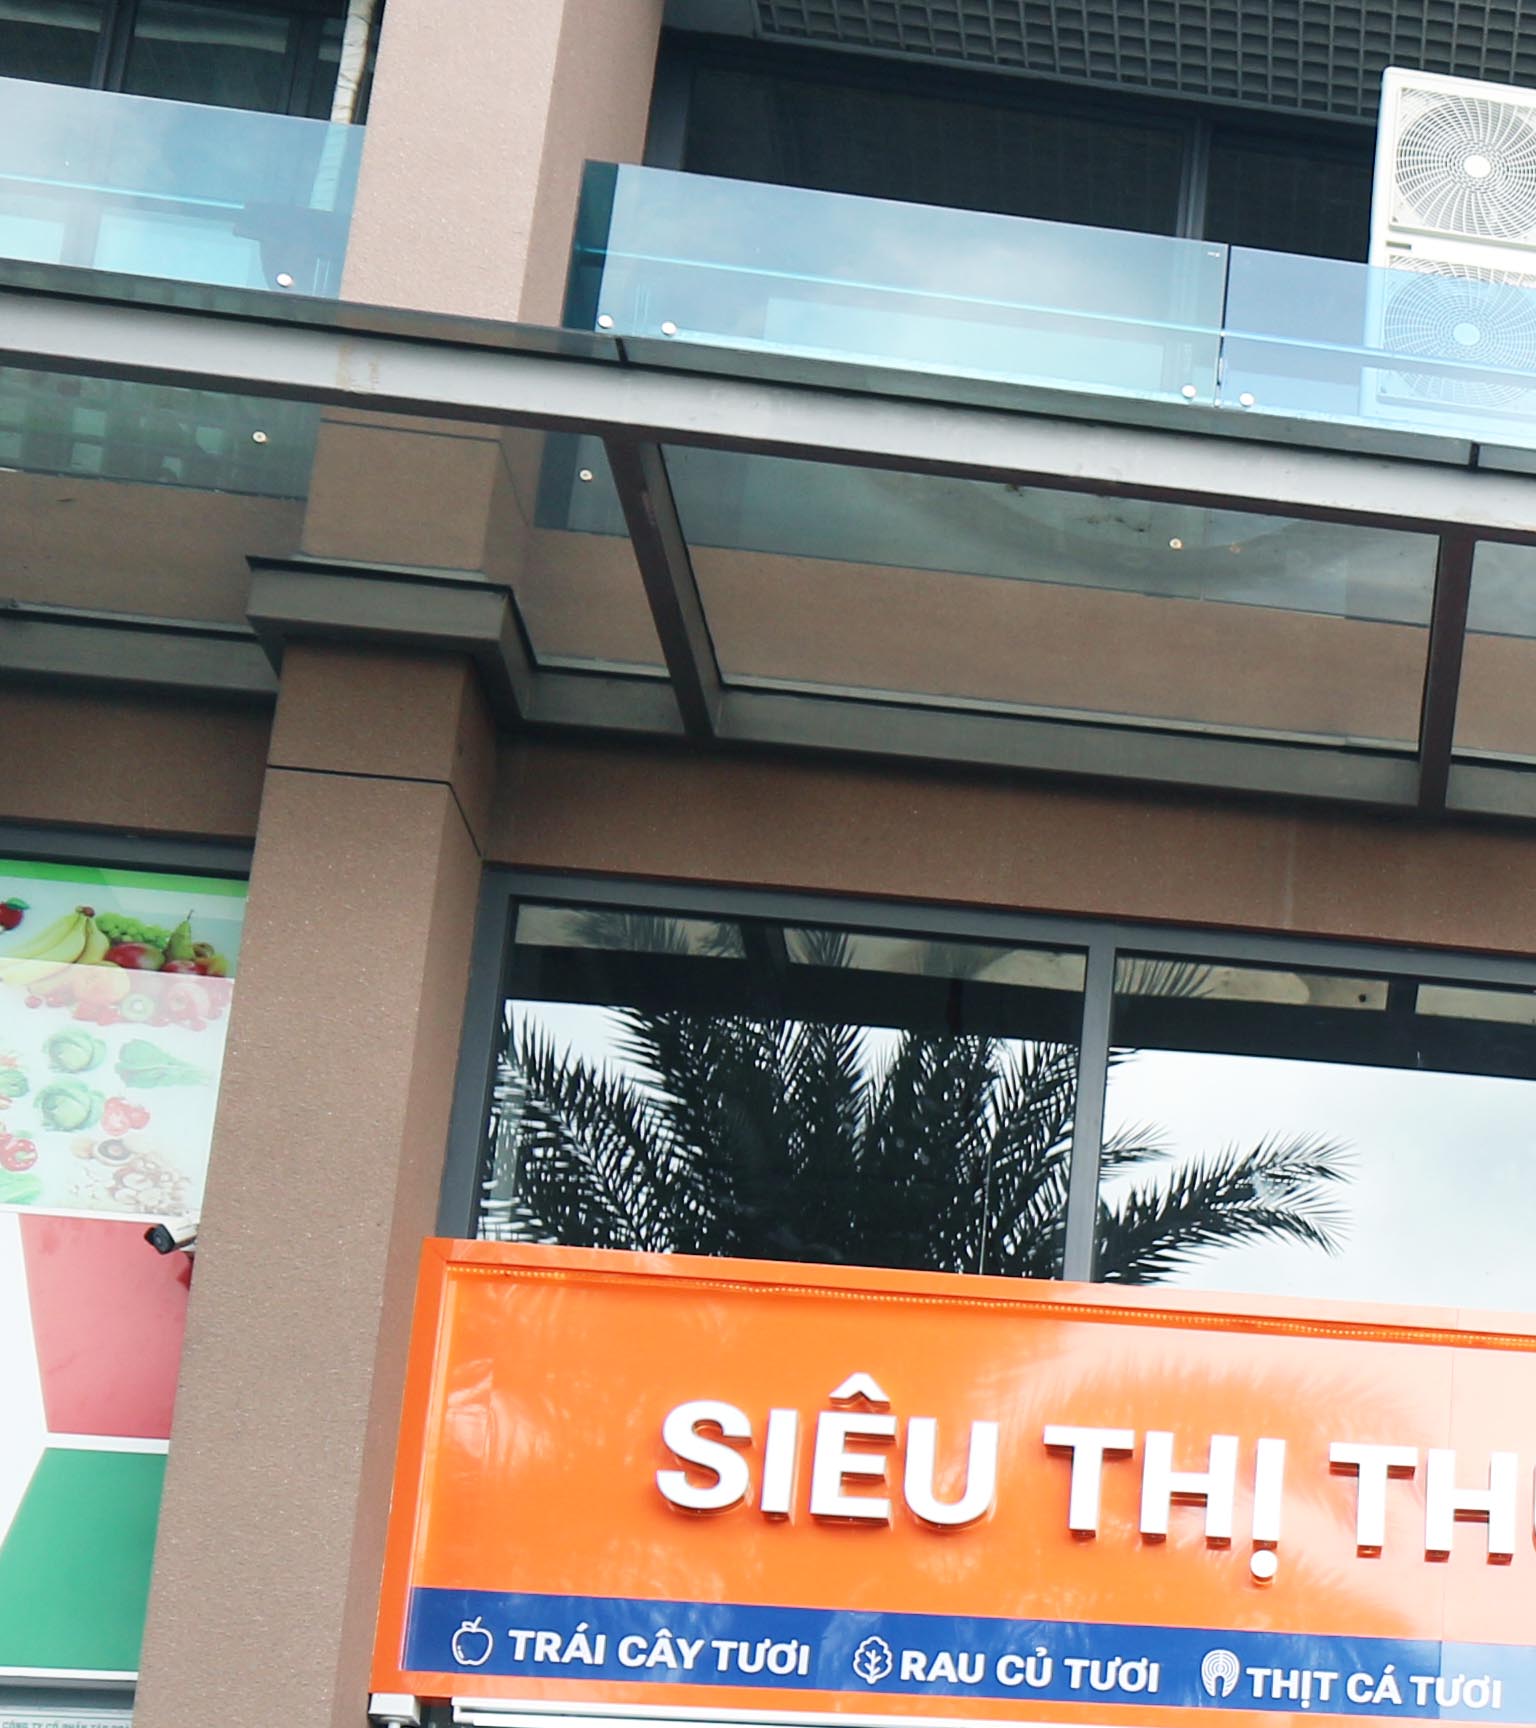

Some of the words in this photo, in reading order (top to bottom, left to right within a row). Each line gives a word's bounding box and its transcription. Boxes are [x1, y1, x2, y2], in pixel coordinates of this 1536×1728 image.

[656, 1373, 999, 1527] SIÊU
[1043, 1425, 1286, 1580] THỊ
[508, 1622, 603, 1666] TRÁI
[617, 1626, 705, 1670] CÂY
[712, 1638, 809, 1677] TƯƠI
[900, 1649, 986, 1685] RAU
[996, 1644, 1056, 1690] CỦ
[1066, 1657, 1160, 1694] TƯƠI
[1246, 1667, 1340, 1713] THỊT
[1347, 1663, 1402, 1706] CÁ
[1410, 1672, 1502, 1710] TƯƠI
